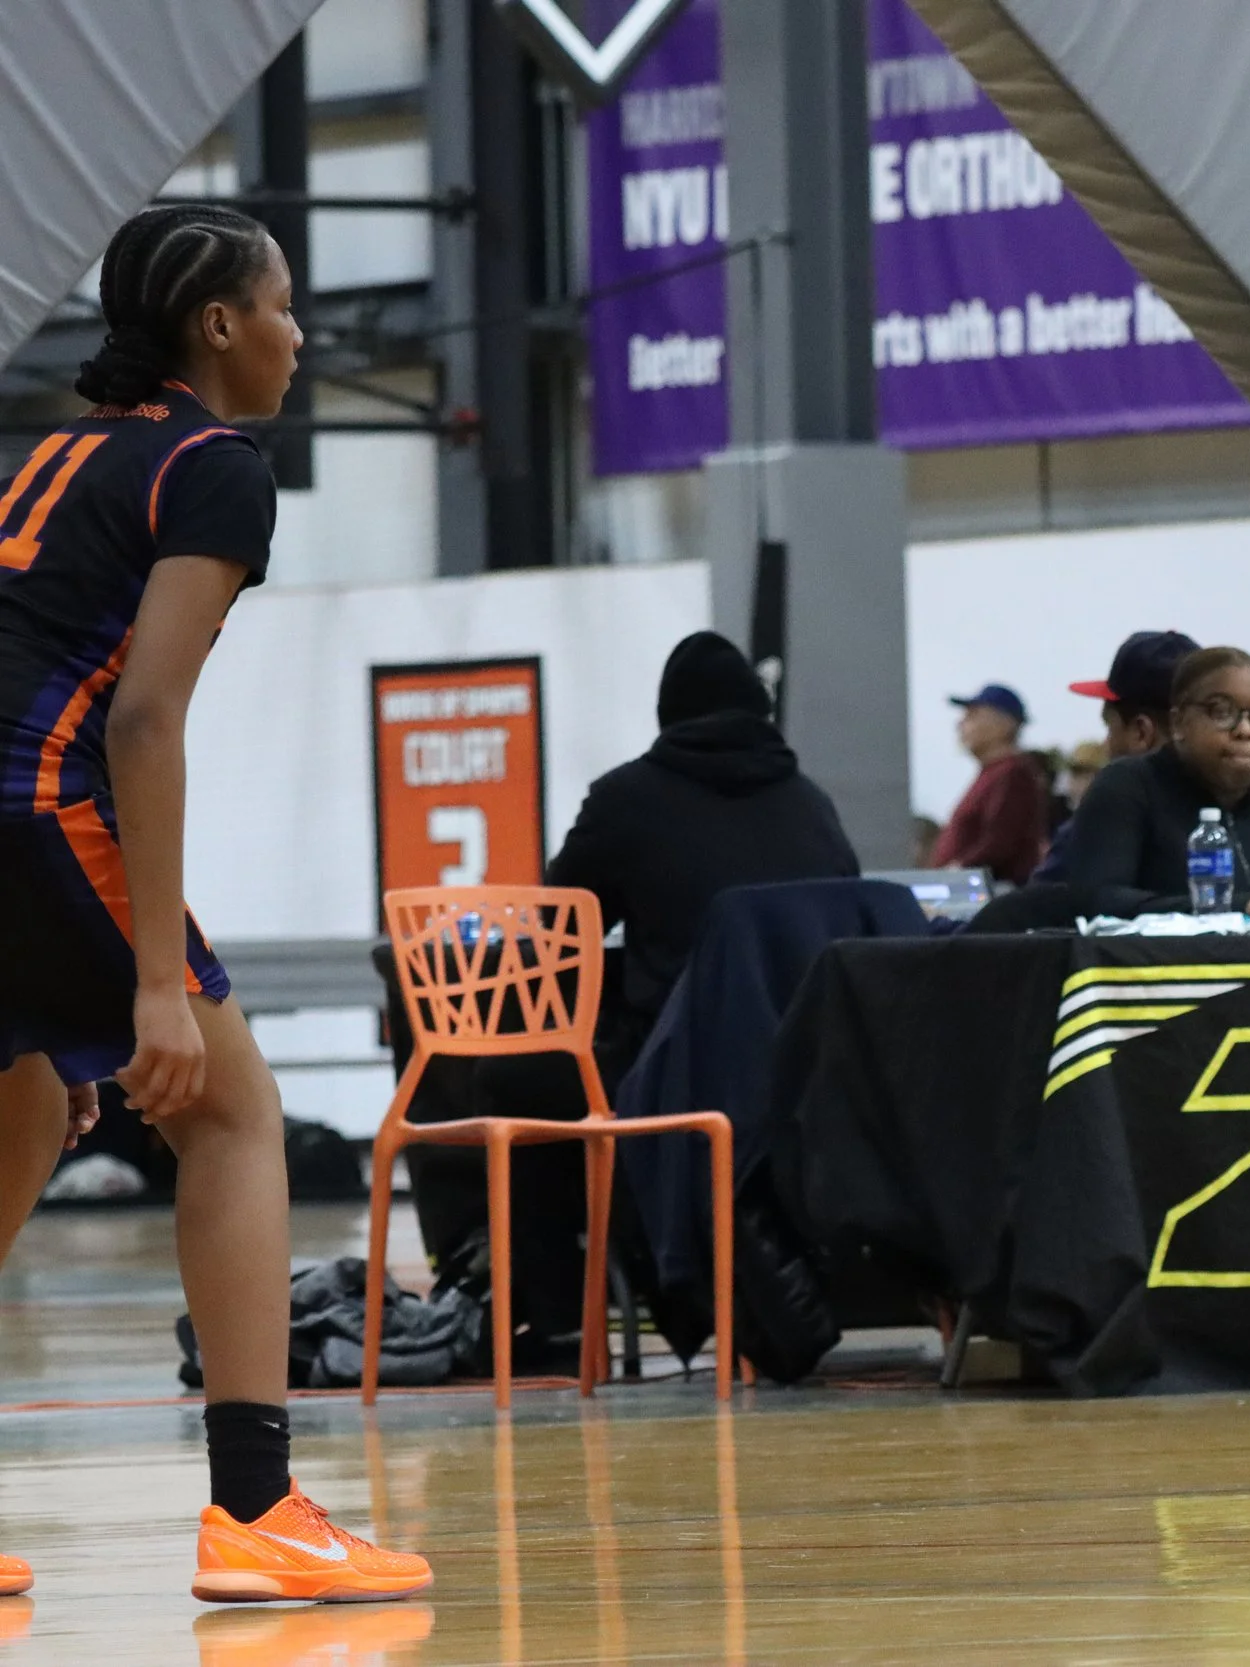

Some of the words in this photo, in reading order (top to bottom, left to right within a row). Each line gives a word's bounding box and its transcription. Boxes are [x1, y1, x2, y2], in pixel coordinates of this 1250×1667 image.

[622, 163, 709, 250] NYU
[628, 332, 724, 391] Better
[924, 296, 996, 364] with
[999, 305, 1025, 358] a
[1025, 290, 1132, 356] better
[402, 726, 510, 787] COURT
